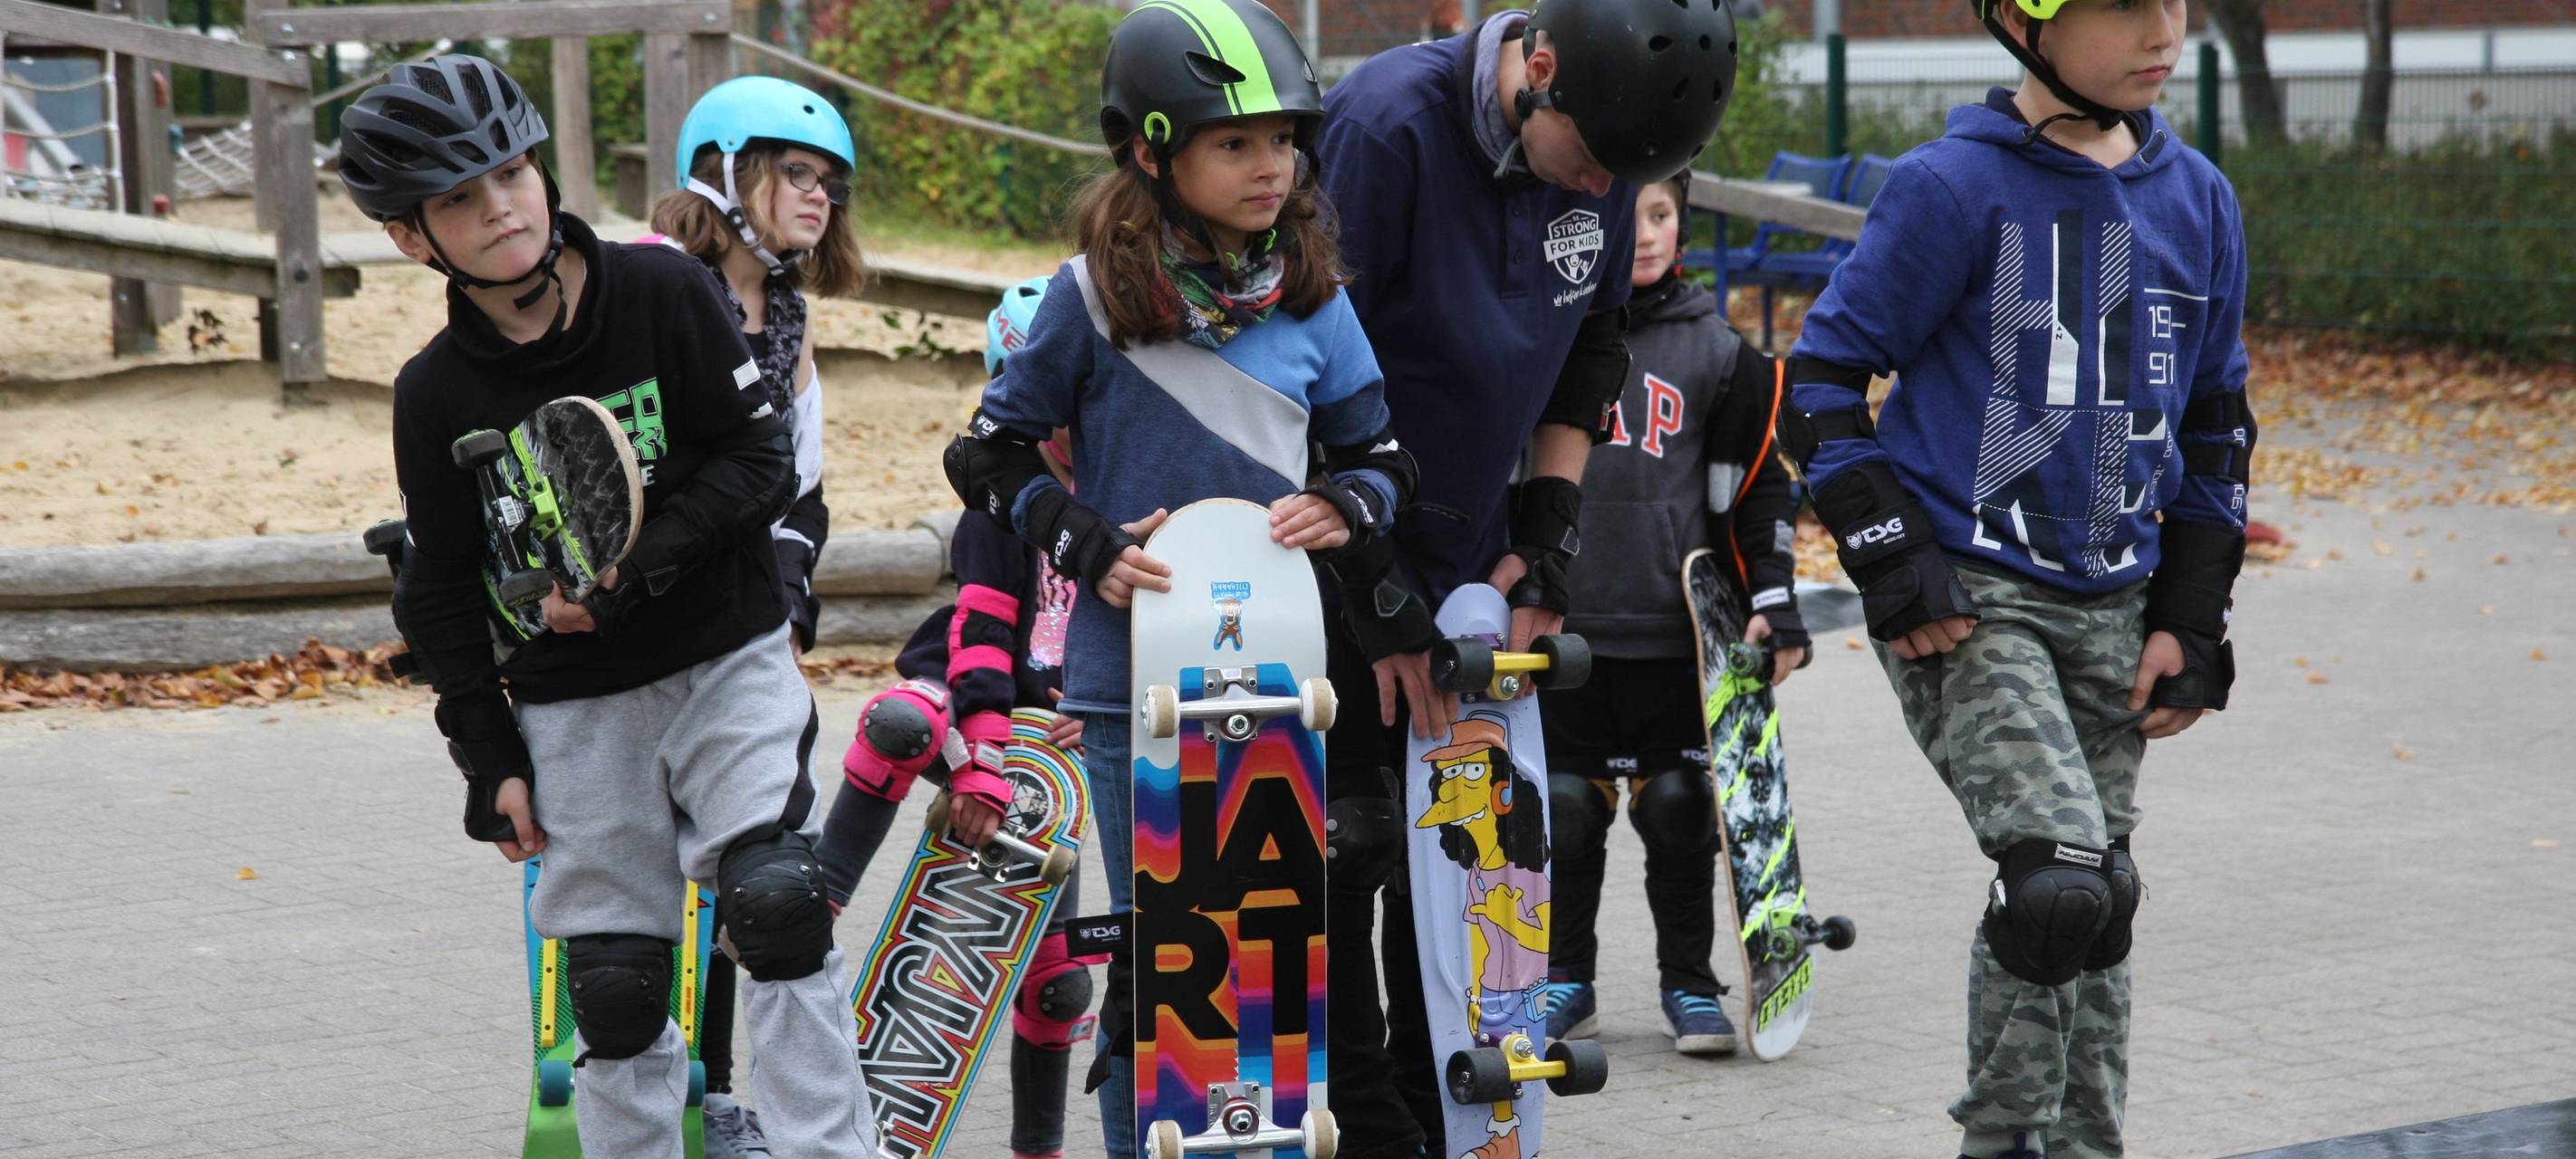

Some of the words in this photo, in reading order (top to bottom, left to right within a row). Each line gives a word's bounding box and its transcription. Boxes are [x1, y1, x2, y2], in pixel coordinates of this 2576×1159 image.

[1553, 218, 1596, 238] STRONG
[1550, 239, 1577, 255] FOR
[1579, 233, 1600, 248] KIDS
[2148, 351, 2175, 385] 91
[1860, 516, 1904, 543] TSG
[1091, 924, 1121, 938] TSG
